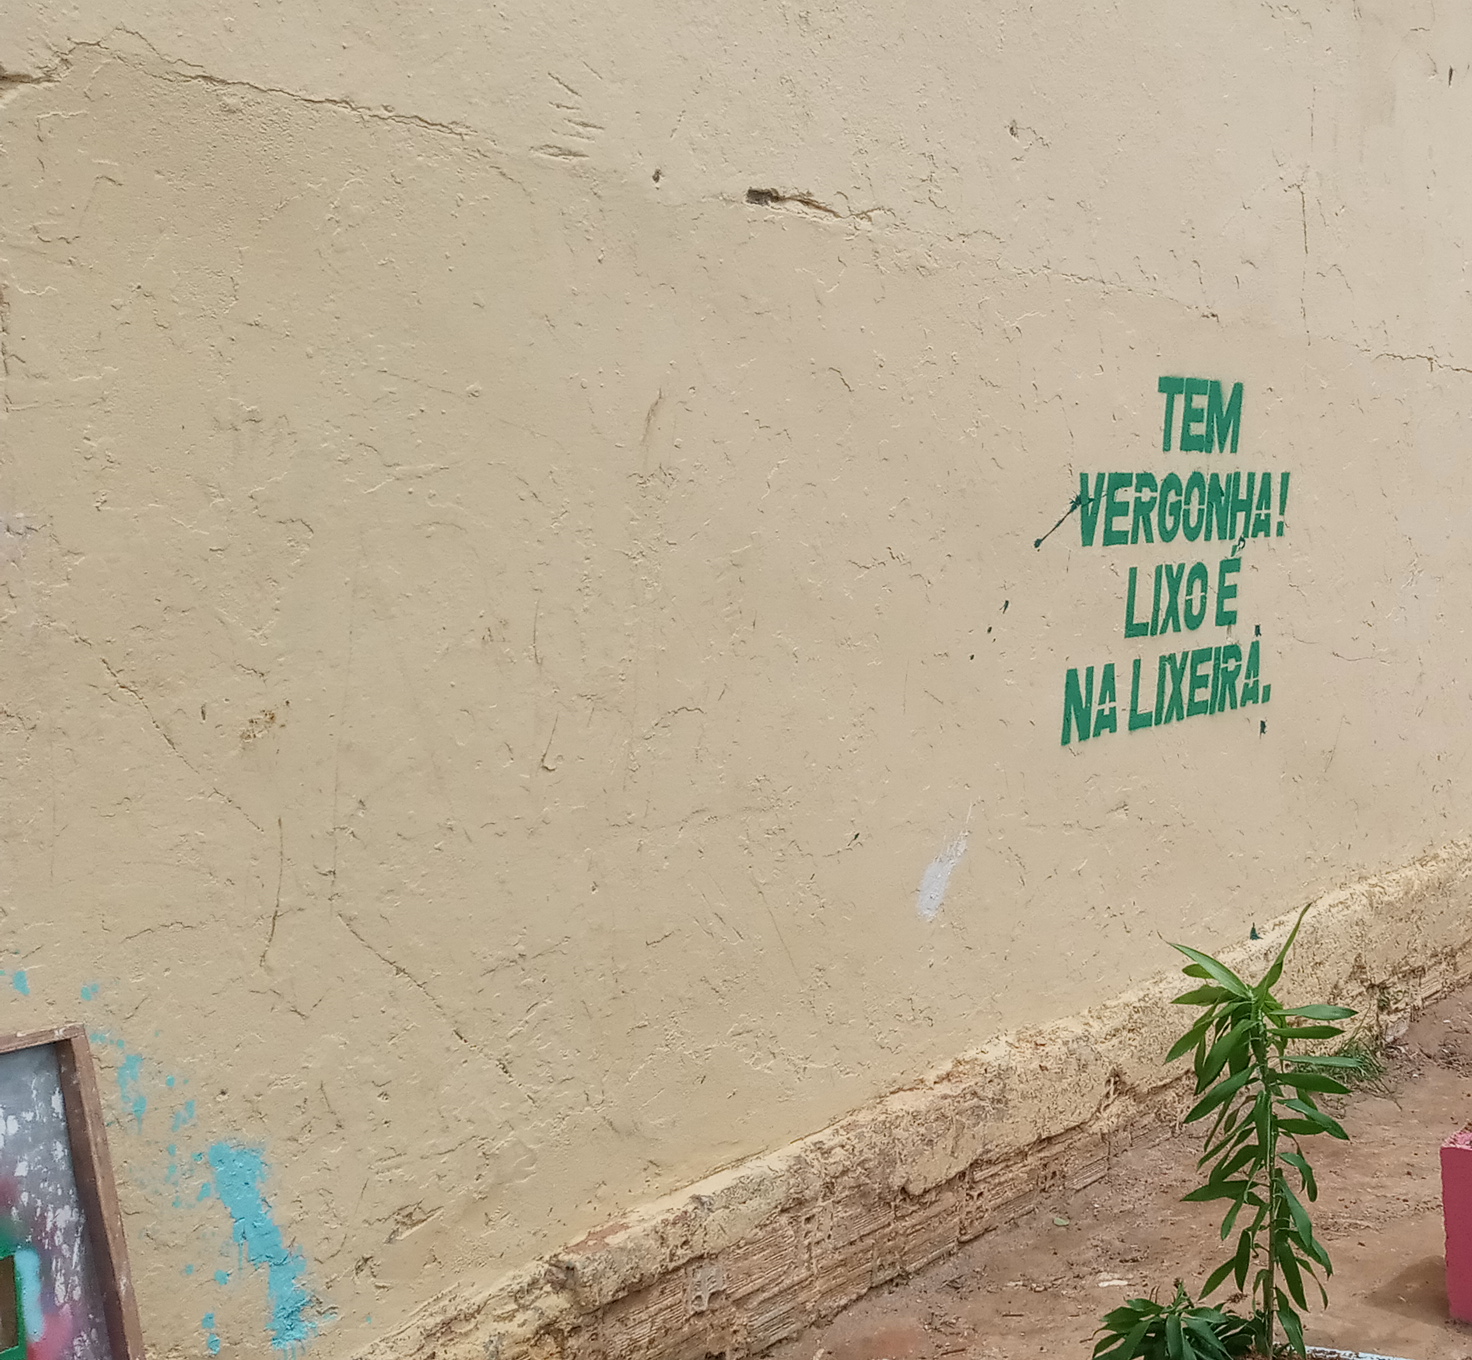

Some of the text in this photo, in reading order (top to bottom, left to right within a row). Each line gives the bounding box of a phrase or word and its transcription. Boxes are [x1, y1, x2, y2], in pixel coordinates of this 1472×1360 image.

[1158, 375, 1244, 454] TEM
[1079, 471, 1291, 547] VERGONHA!
[1124, 537, 1242, 639] LIXO É
[1061, 640, 1272, 747] NA LIXEIRA.
